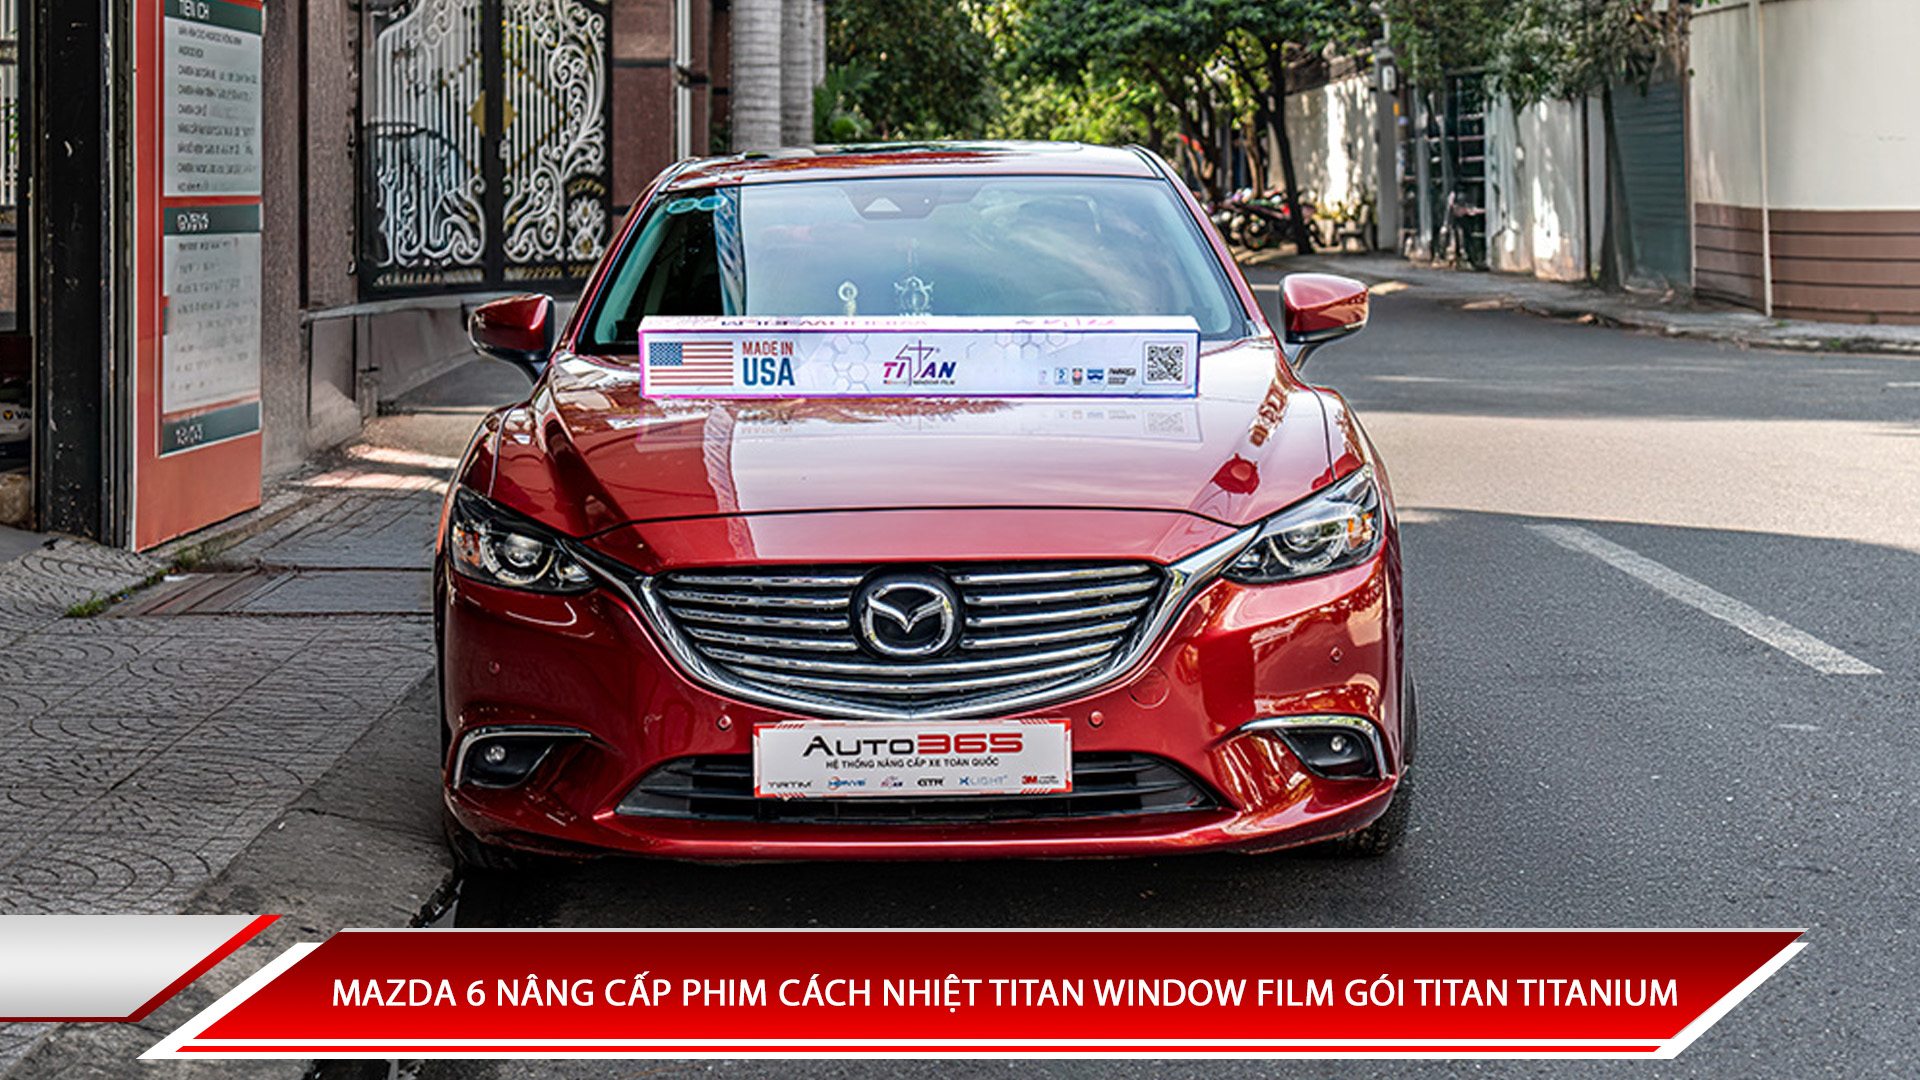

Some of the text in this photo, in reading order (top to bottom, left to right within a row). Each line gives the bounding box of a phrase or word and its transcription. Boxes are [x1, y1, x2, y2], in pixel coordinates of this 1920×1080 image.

[742, 341, 794, 356] MADE IN
[743, 357, 795, 386] USA
[929, 758, 940, 767] XE
[1021, 775, 1038, 785] 3M
